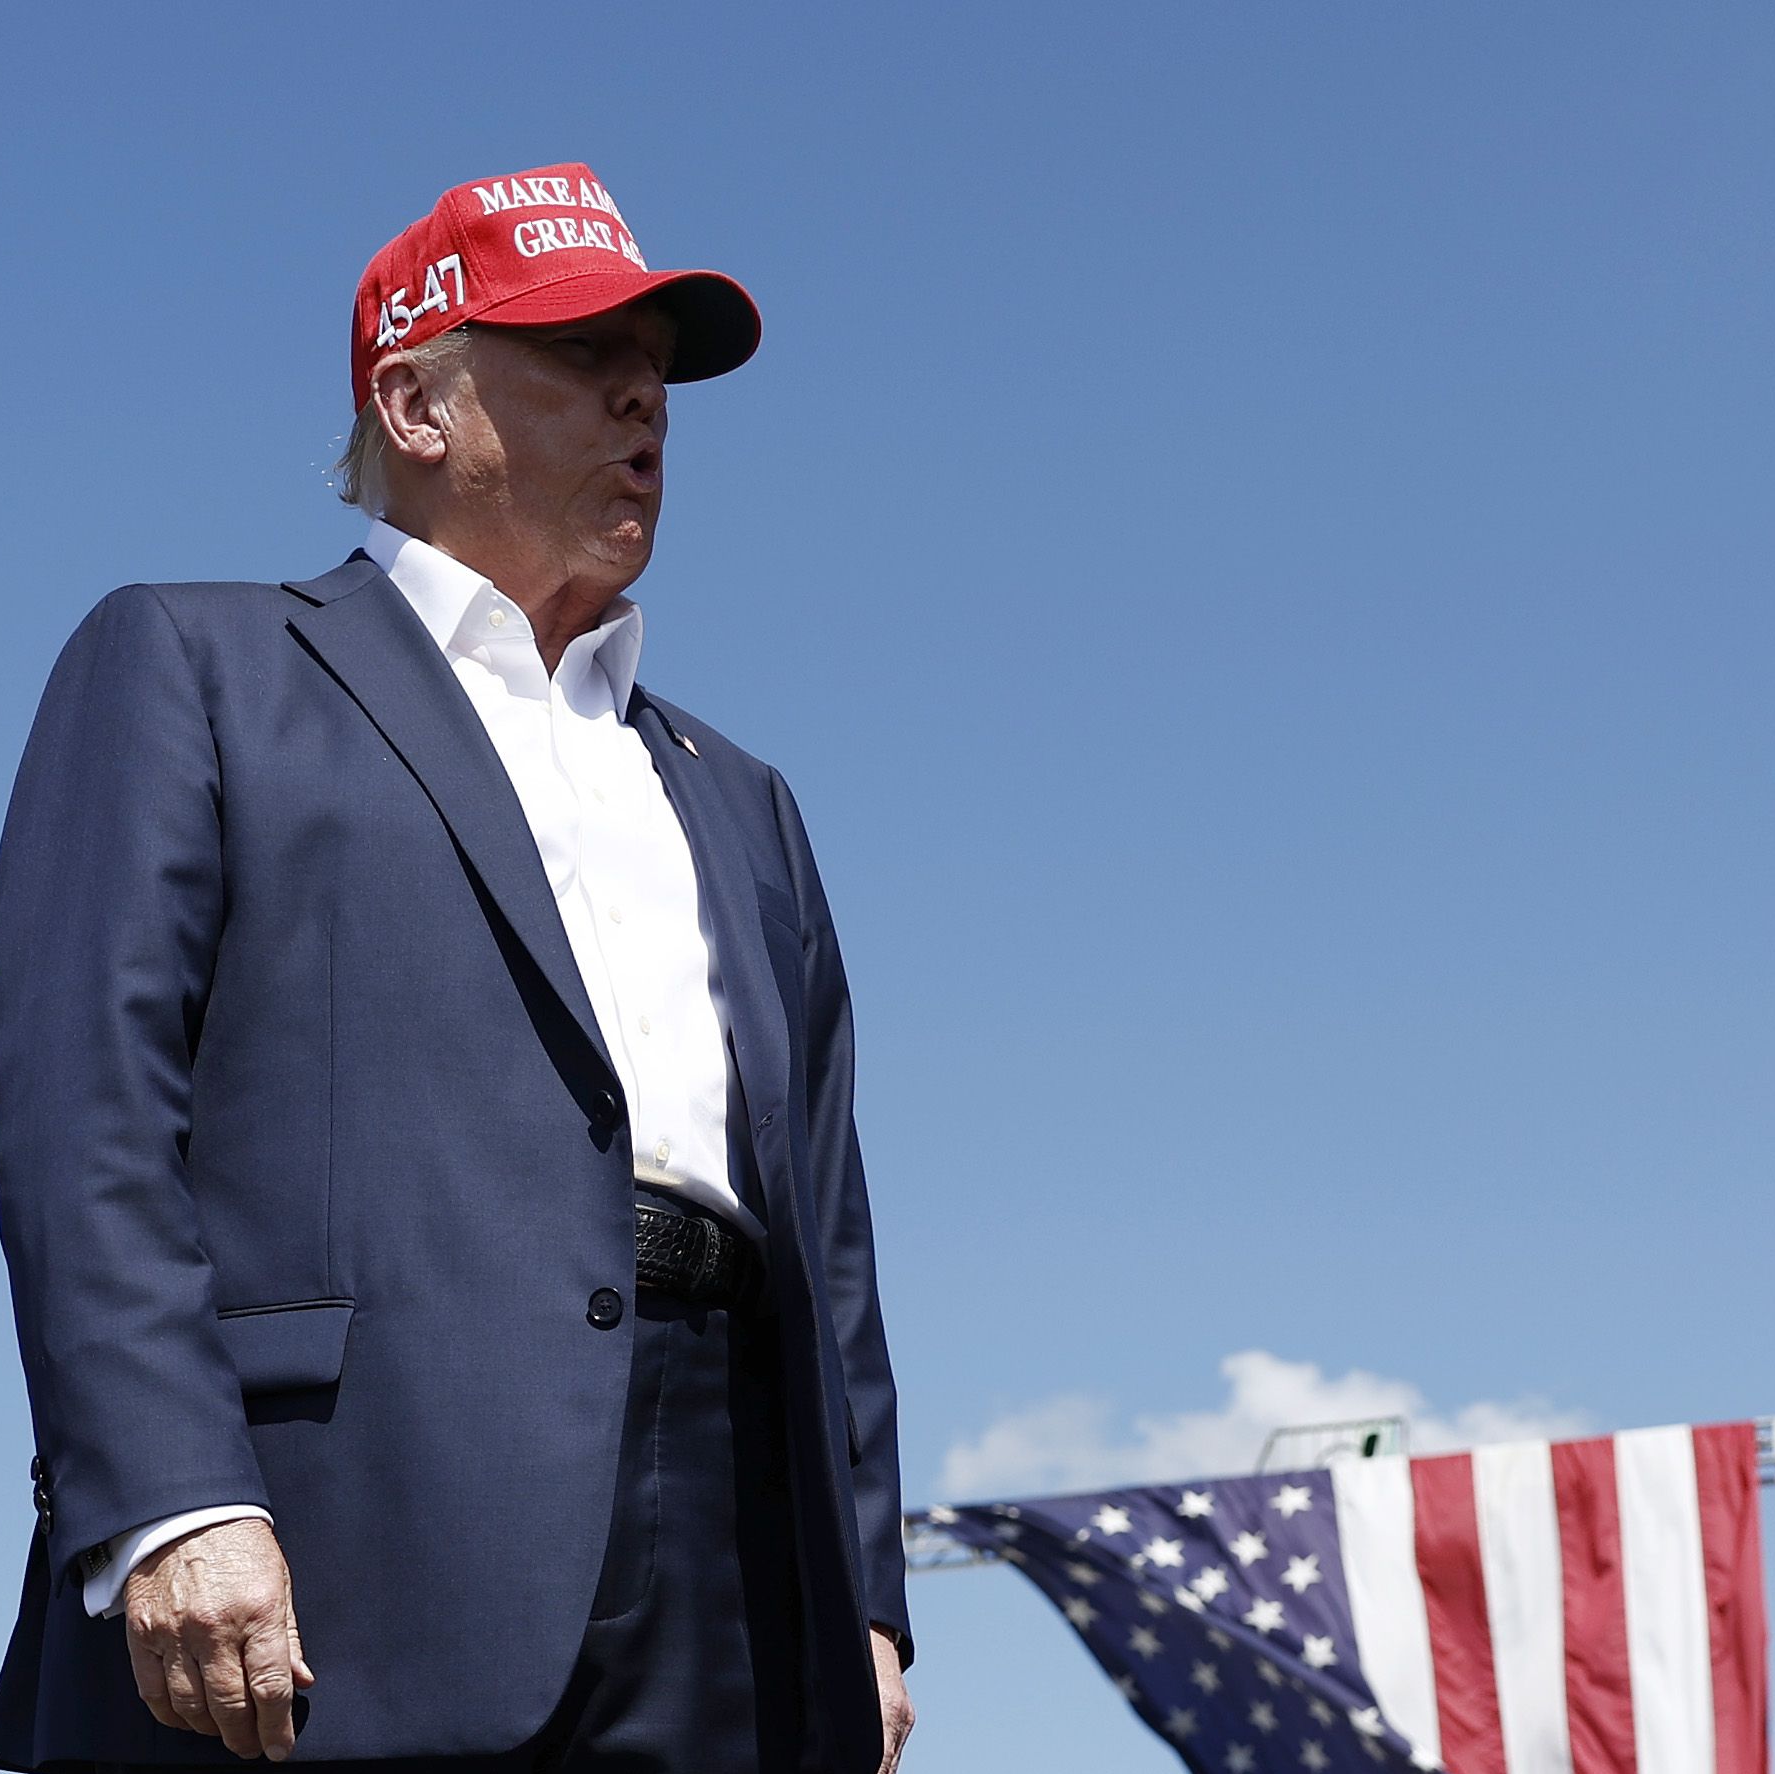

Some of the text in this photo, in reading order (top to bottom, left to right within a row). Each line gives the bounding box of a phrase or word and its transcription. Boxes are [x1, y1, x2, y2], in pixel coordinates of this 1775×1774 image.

[472, 177, 577, 215] MAKE
[514, 218, 618, 258] GREAT
[376, 253, 465, 348] 45-47
